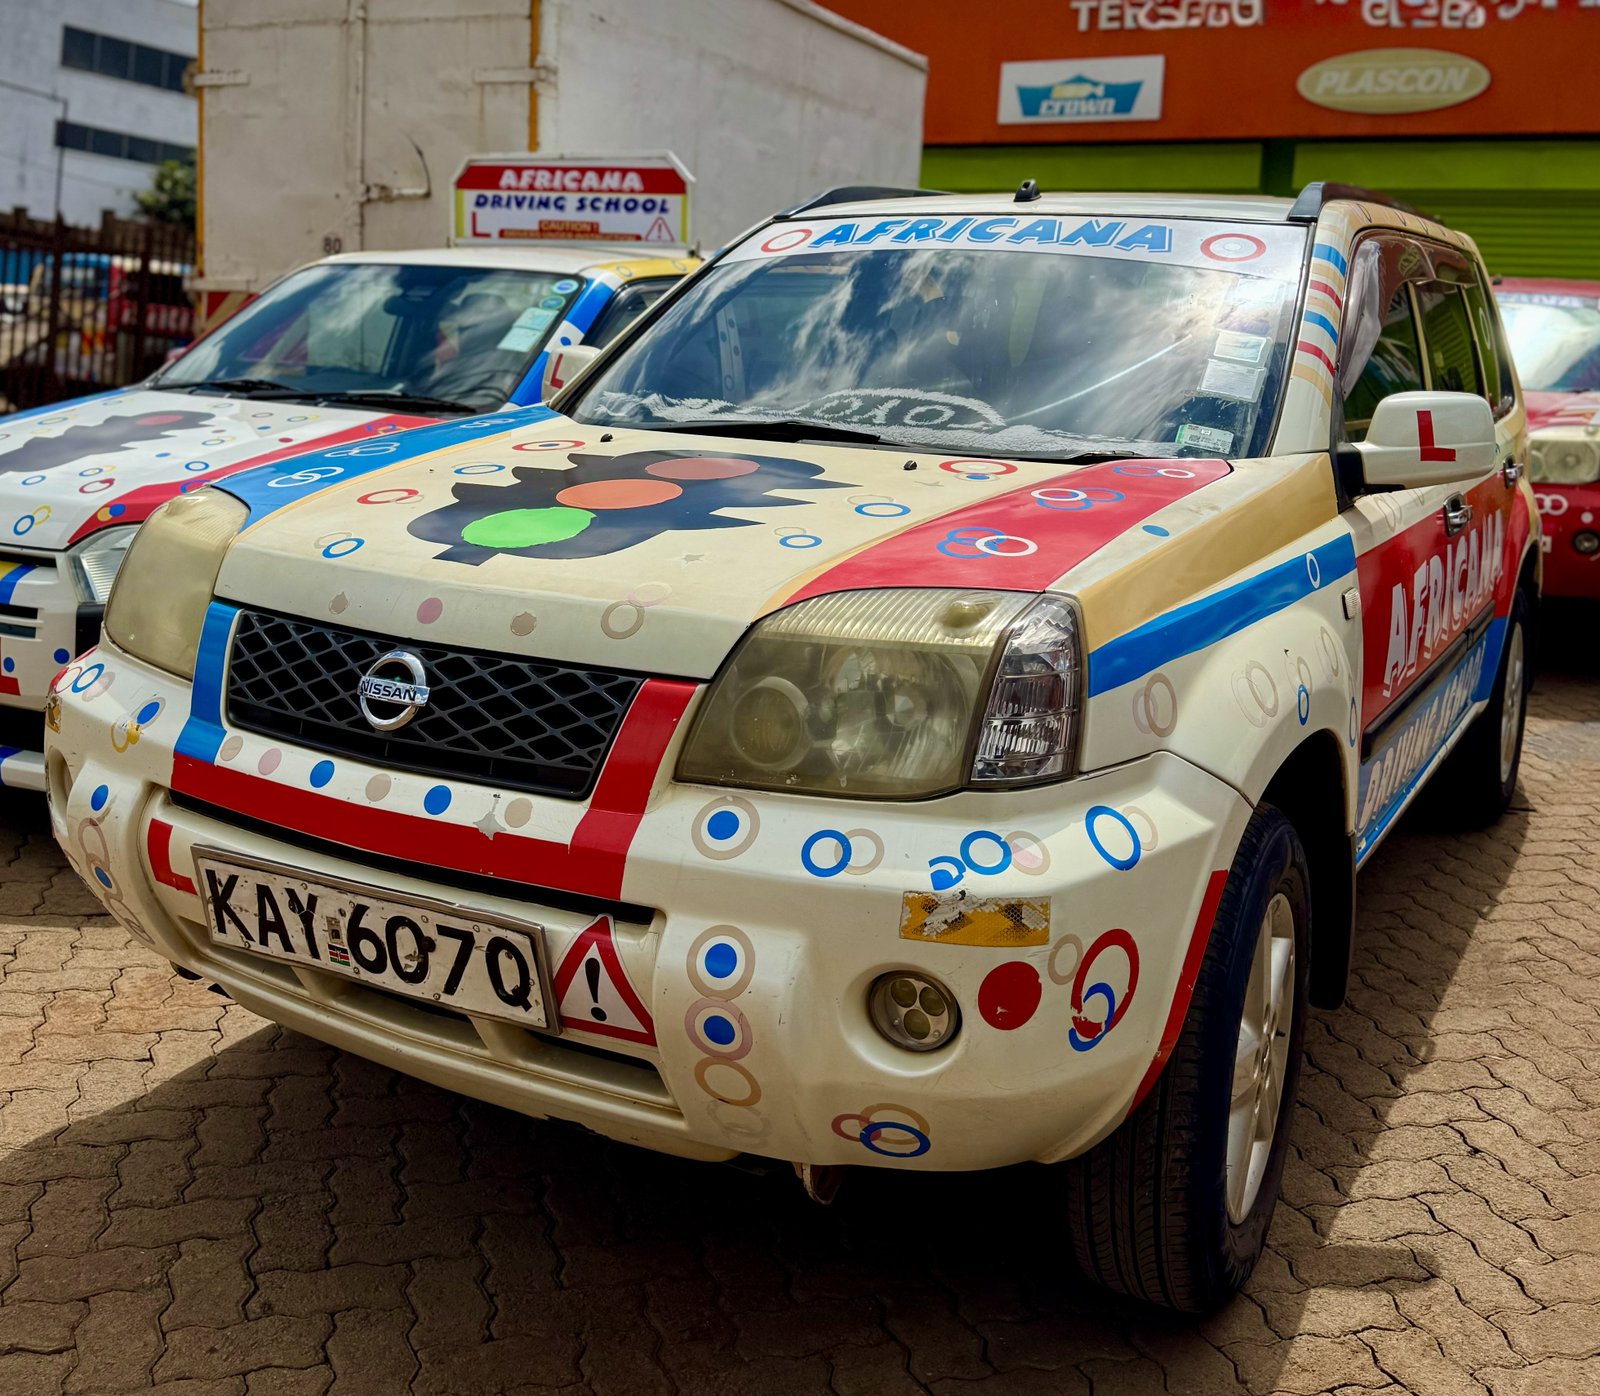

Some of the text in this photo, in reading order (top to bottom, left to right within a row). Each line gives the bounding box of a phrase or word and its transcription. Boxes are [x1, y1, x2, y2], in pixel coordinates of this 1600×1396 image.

[1315, 67, 1470, 96] PLASCON
[500, 169, 644, 191] AFRICANA
[474, 194, 669, 213] DRIVING SCHOOL
[471, 211, 492, 238] L
[809, 217, 1173, 253] AFRICANA
[550, 353, 565, 390] L
[1416, 410, 1456, 462] L
[1382, 509, 1505, 699] AFRICANA
[360, 680, 417, 702] NISSAN
[1358, 695, 1440, 836] DRIVING
[147, 818, 199, 896] L
[205, 869, 534, 1012] KAY 607Q
